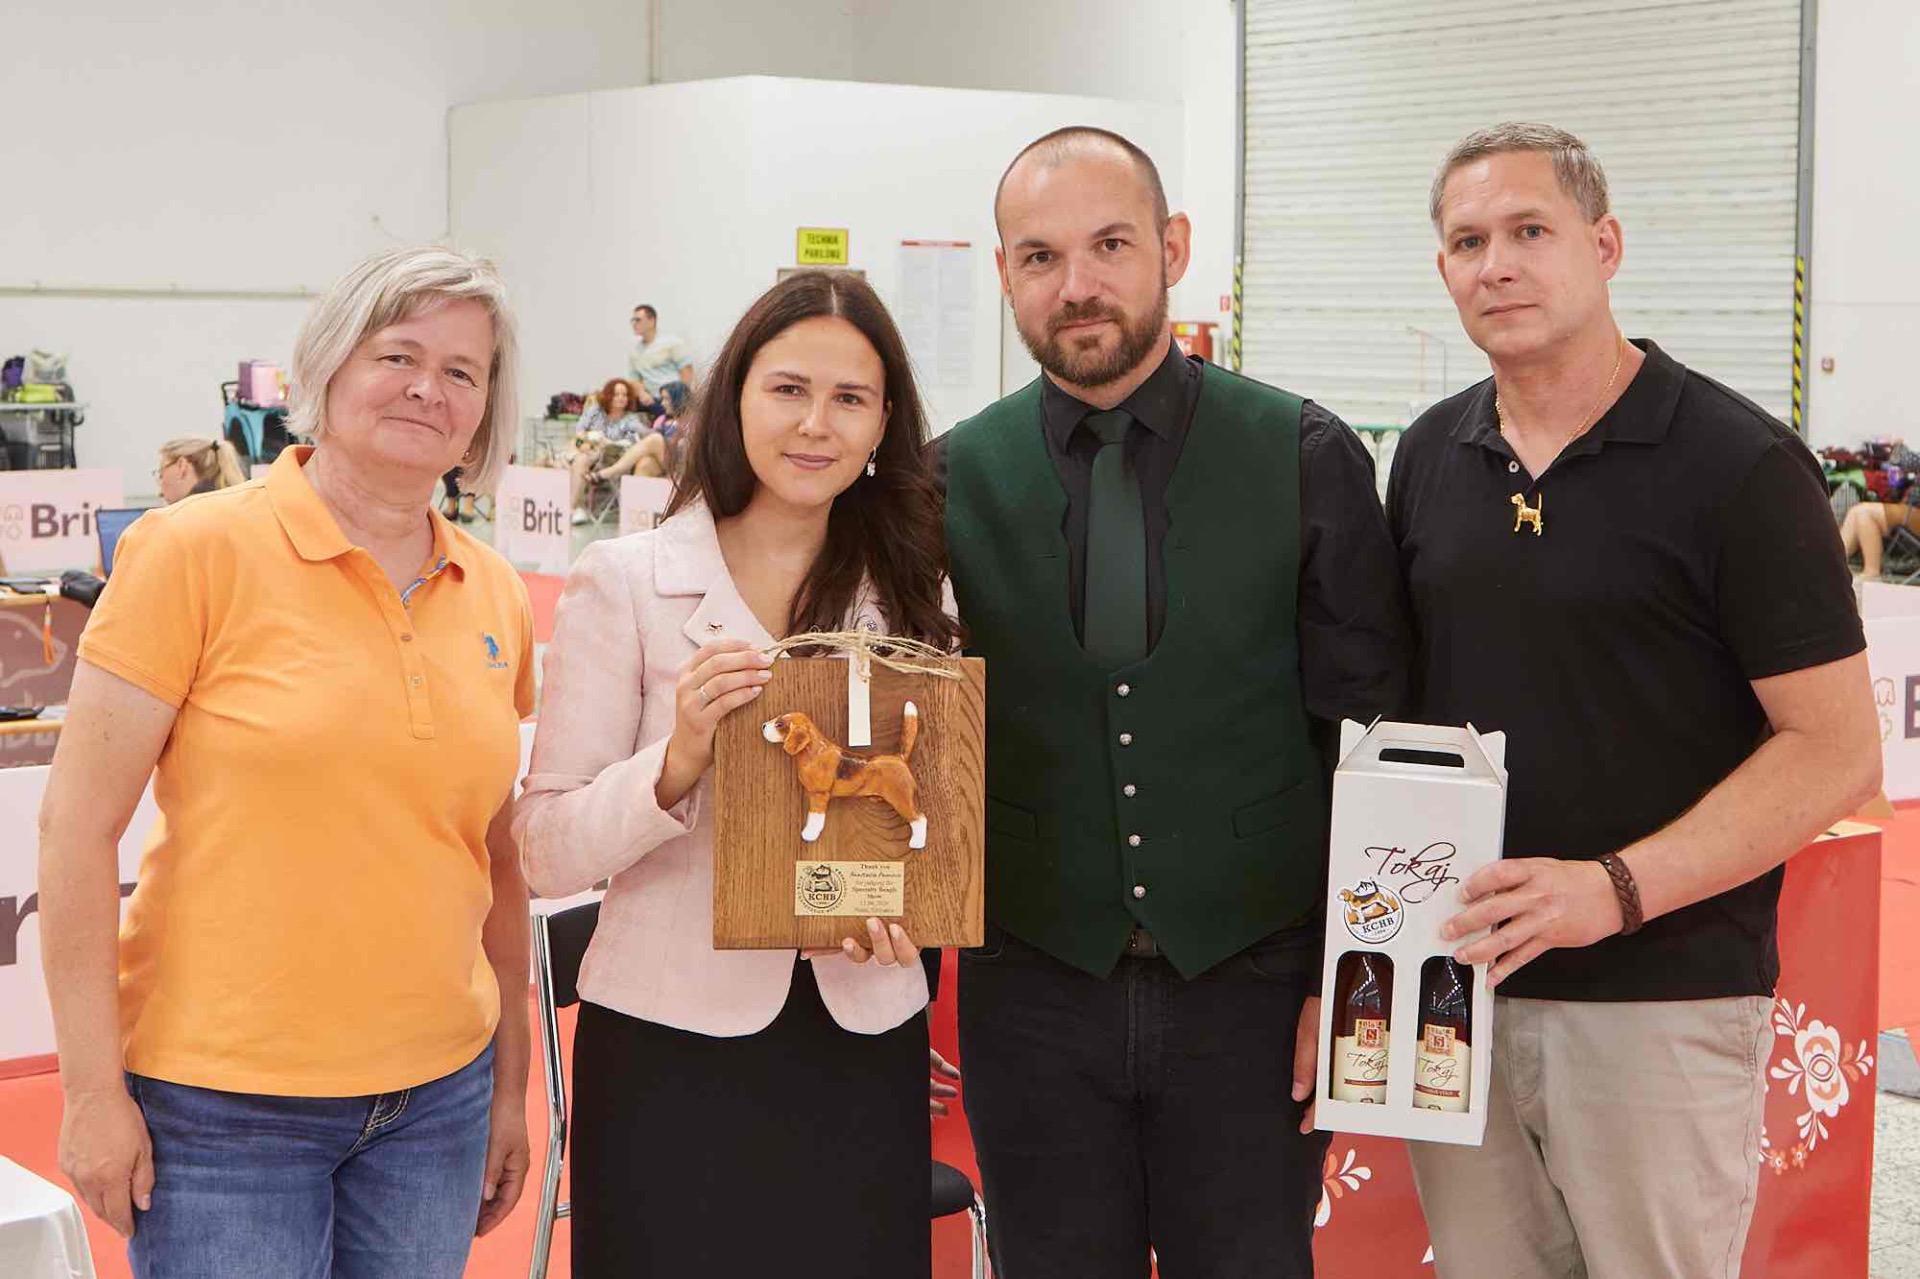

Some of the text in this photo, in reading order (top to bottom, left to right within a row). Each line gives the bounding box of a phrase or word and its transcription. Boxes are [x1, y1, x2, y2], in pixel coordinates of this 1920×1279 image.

[31, 502, 96, 538] Bri
[523, 498, 563, 535] Brit
[1365, 842, 1459, 903] Tokaj
[808, 893, 837, 901] KCHB
[1362, 917, 1394, 933] KCHB
